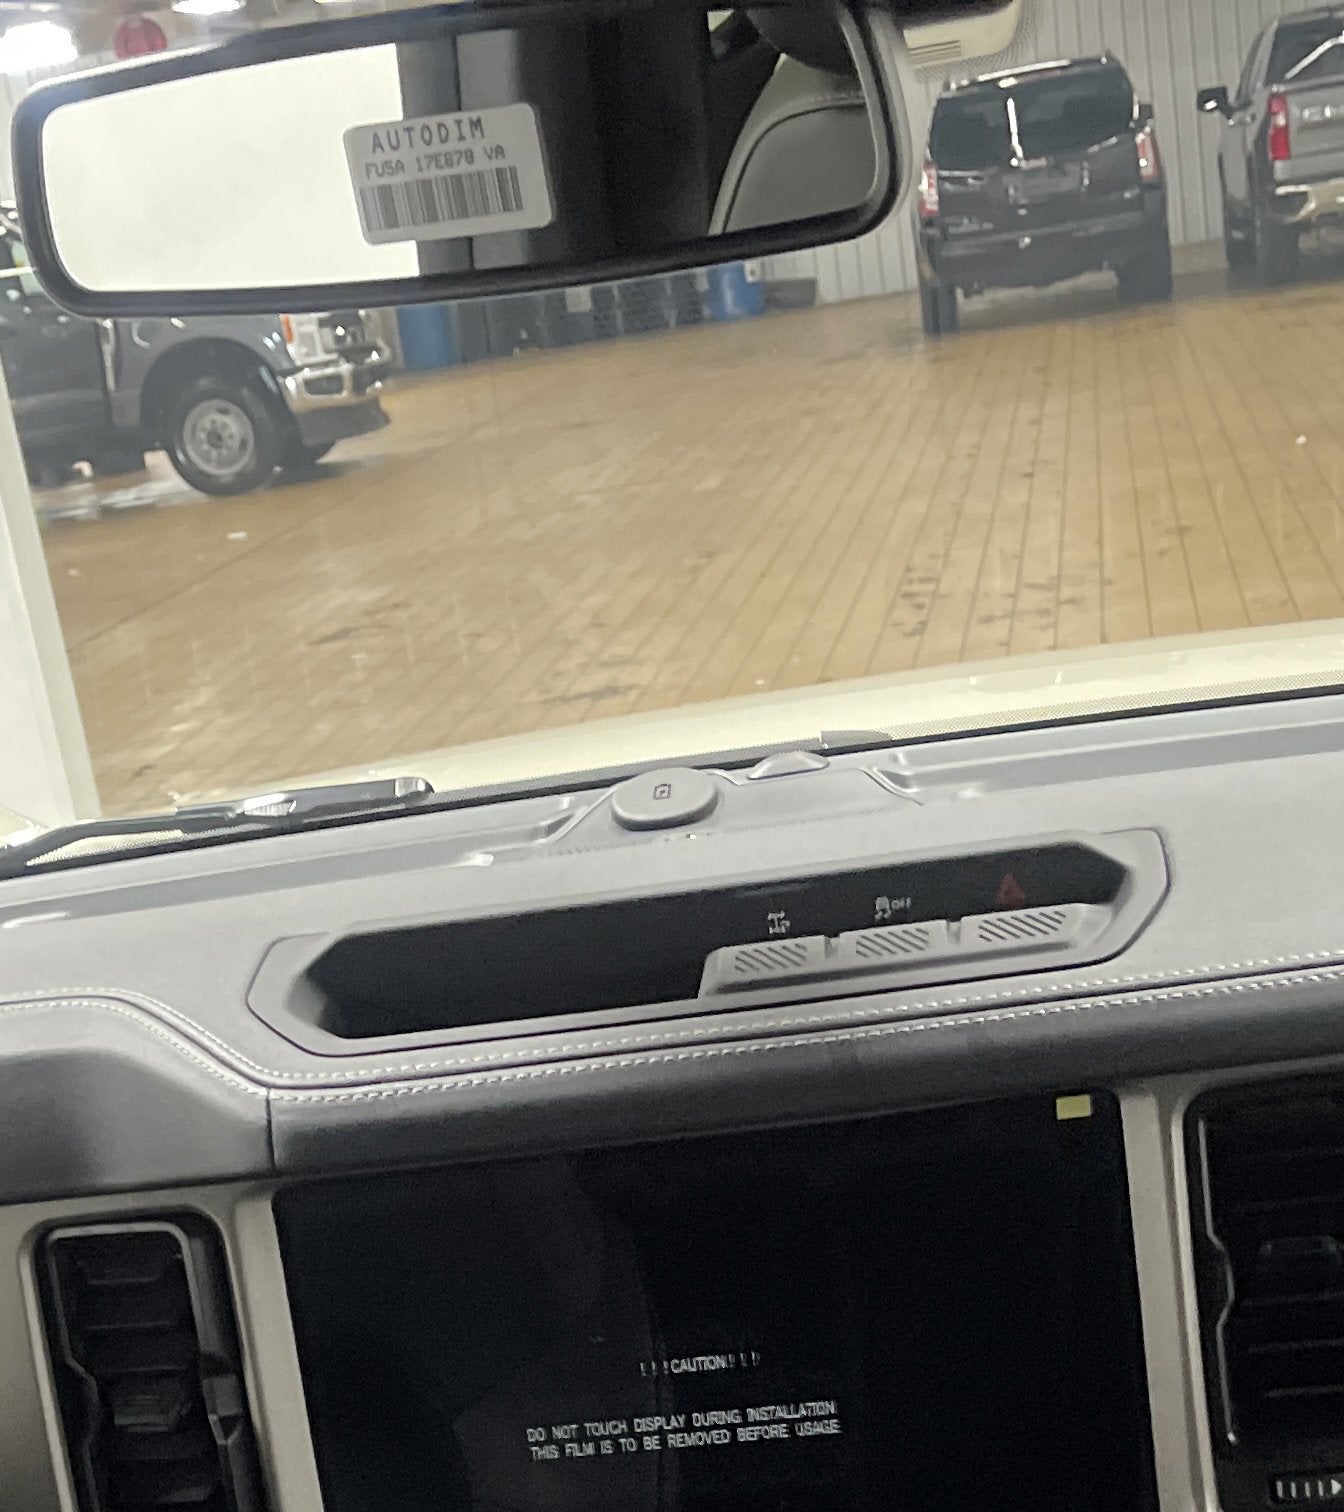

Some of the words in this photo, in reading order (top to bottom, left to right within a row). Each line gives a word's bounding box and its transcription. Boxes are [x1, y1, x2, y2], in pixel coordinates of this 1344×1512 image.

[372, 116, 485, 154] AUTODIM
[365, 159, 405, 179] FU5A
[483, 144, 506, 161] VA
[526, 1427, 546, 1443] DO
[552, 1424, 579, 1441] NOT
[585, 1419, 627, 1437] TOUCH
[633, 1414, 686, 1433] DISPLAY
[692, 1409, 742, 1428] DURING
[747, 1401, 837, 1422] INSTALLATION
[530, 1446, 560, 1461] THIS
[565, 1442, 595, 1459] FILM
[600, 1441, 613, 1456] IS
[619, 1438, 638, 1454] TO
[643, 1435, 662, 1451] BE
[667, 1430, 732, 1449] REMOVED
[737, 1424, 789, 1443] BEFORE
[795, 1418, 843, 1437] USAGE
